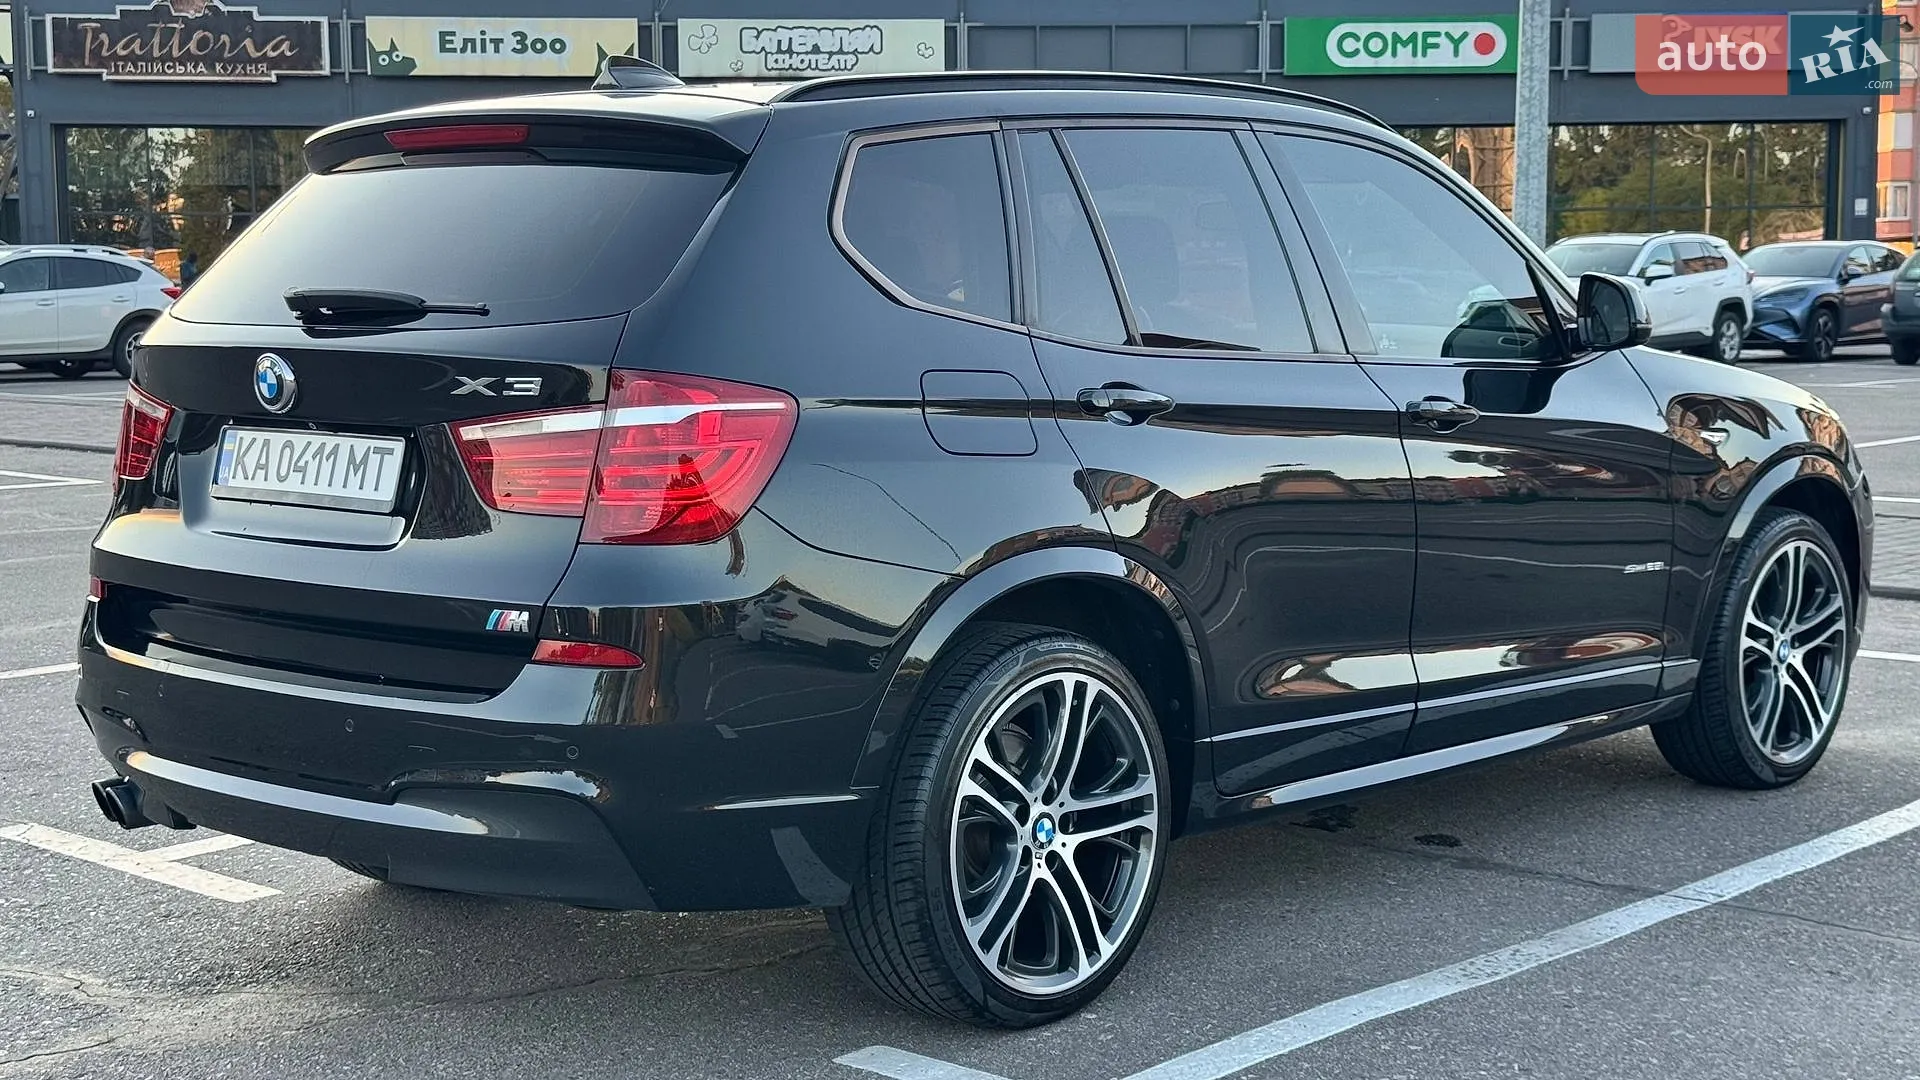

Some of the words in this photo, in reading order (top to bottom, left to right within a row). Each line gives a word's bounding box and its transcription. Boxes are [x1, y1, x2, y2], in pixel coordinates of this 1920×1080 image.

[77, 18, 299, 66] Trattoria
[438, 30, 504, 54] Еліт
[511, 30, 567, 55] Зоо
[1336, 31, 1469, 58] COMFY
[110, 60, 207, 74] ІТАЛІЙСЬКА
[215, 62, 268, 74] КУХНЯ
[766, 53, 857, 70] КІНОТЕАТР
[450, 375, 543, 397] X3
